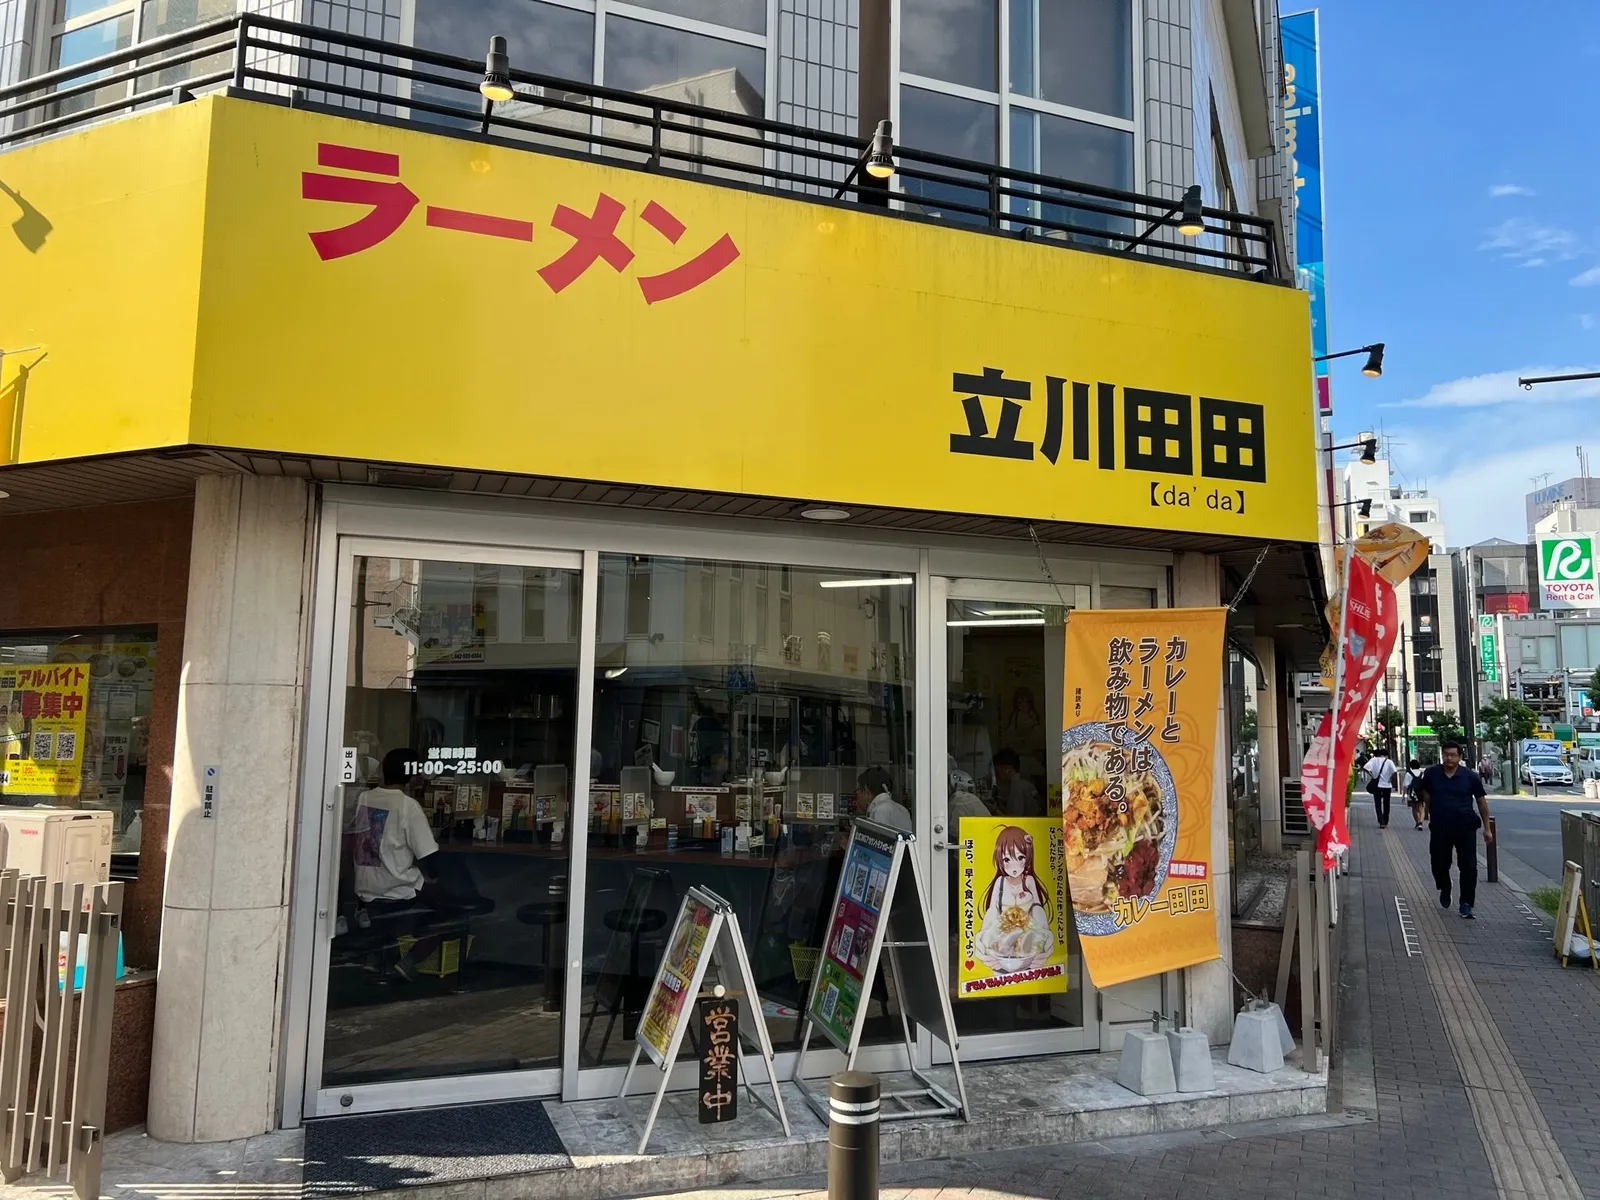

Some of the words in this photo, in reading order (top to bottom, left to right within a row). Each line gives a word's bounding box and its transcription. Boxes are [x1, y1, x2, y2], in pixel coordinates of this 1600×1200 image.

[302, 142, 741, 305] ラーメン
[950, 366, 1266, 483] 立川田田
[1545, 583, 1594, 592] TOYOTA
[1546, 593, 1567, 601] Rent
[1577, 592, 1594, 600] Car
[17, 667, 85, 689] アルバイト
[1161, 635, 1187, 743] カレーと
[22, 691, 83, 719] 募集中
[1130, 637, 1159, 772] ラーメンは
[1104, 637, 1134, 813] 飲み物である。
[344, 751, 353, 780] 出入口
[428, 748, 477, 760] 営業時間
[204, 785, 213, 818] 駐車禁止
[1170, 863, 1205, 876] 期間限定
[1113, 883, 1209, 928] カレー田田
[703, 1005, 736, 1121] 営業中
